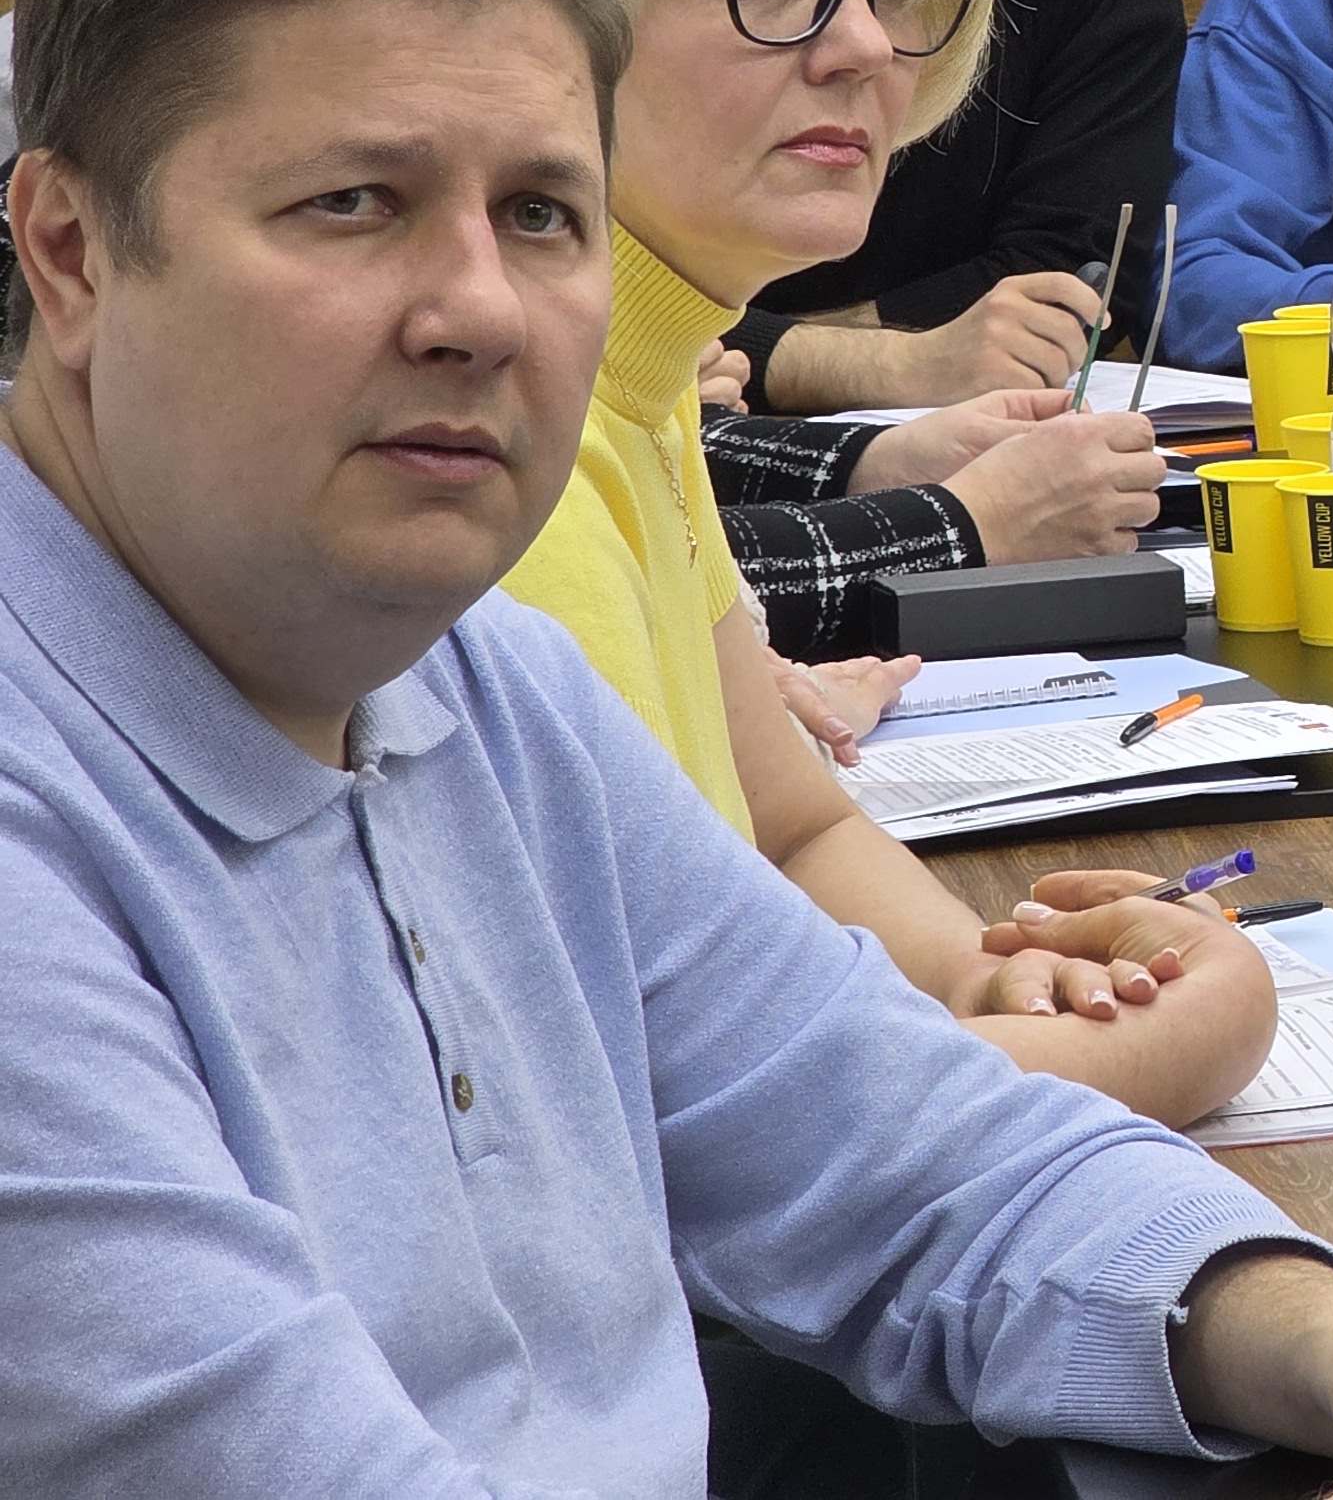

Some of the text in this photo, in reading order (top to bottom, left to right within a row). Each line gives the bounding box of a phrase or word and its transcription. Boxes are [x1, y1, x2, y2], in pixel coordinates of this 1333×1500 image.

[1210, 486, 1227, 548] YELLOW CUP
[1315, 502, 1333, 564] YELLOW CUP
